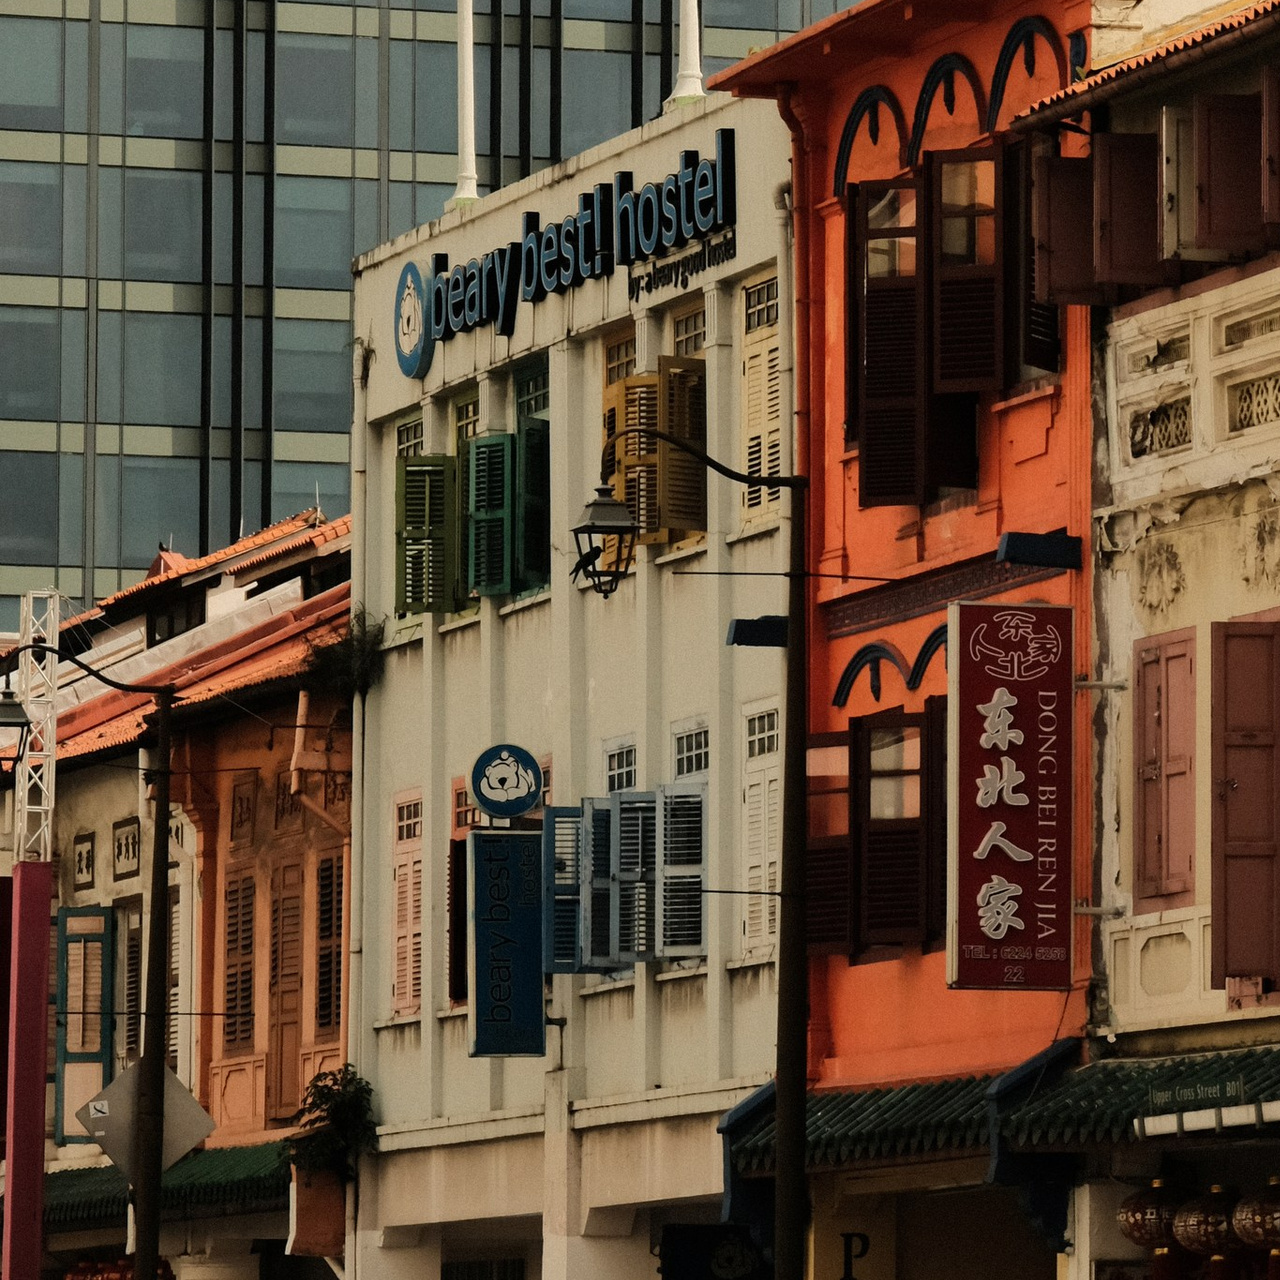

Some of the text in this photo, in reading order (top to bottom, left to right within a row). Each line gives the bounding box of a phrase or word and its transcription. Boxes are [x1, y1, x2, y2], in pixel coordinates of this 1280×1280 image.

[431, 129, 735, 341] beary best! hostel
[519, 839, 536, 906] hostel
[973, 687, 1034, 940] 东北人家
[1033, 691, 1057, 939] DONG BEI REN JIA
[481, 837, 518, 1024] beary best!
[1003, 966, 1025, 983] 22
[1175, 1086, 1195, 1101] Cross
[1196, 1083, 1221, 1100] Street
